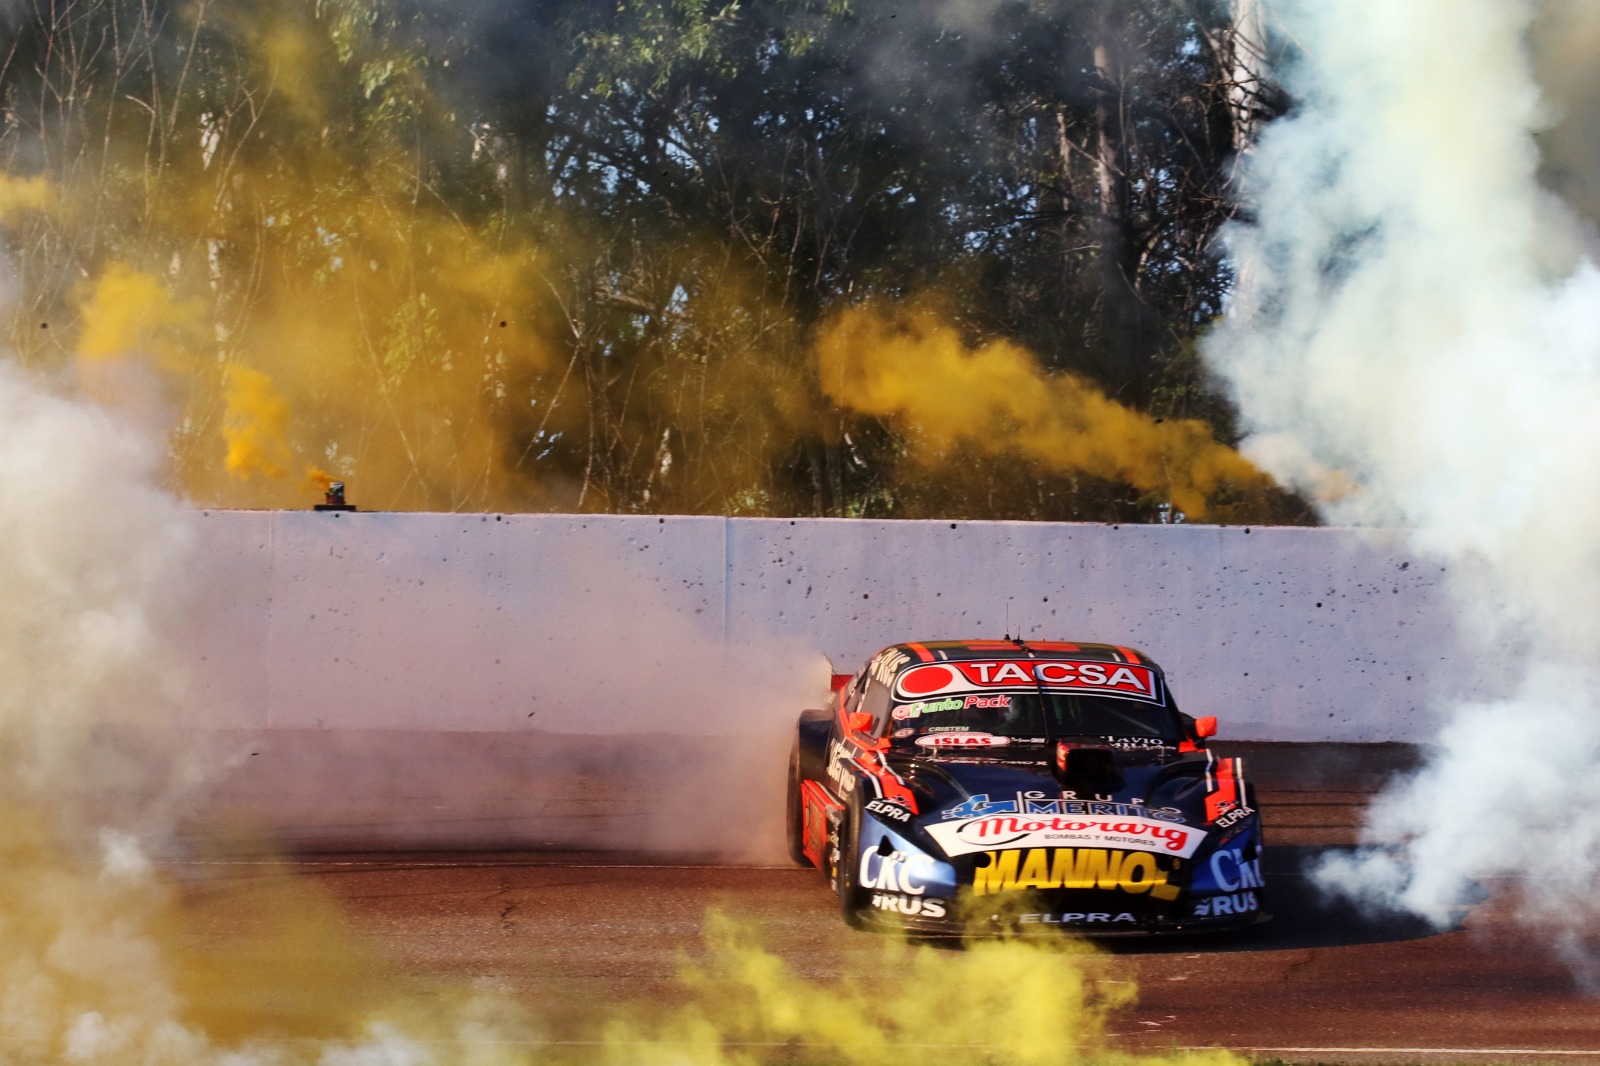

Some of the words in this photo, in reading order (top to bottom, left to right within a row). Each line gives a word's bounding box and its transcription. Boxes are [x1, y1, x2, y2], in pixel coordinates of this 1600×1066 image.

[970, 662, 1147, 691] TACSA
[934, 737, 992, 745] ISLAS
[864, 800, 912, 823] ELPRA
[1214, 806, 1256, 828] ELPRA
[973, 817, 1189, 851] Motorarg
[1103, 835, 1157, 846] MOTORES
[1019, 912, 1136, 924] ELPRA
